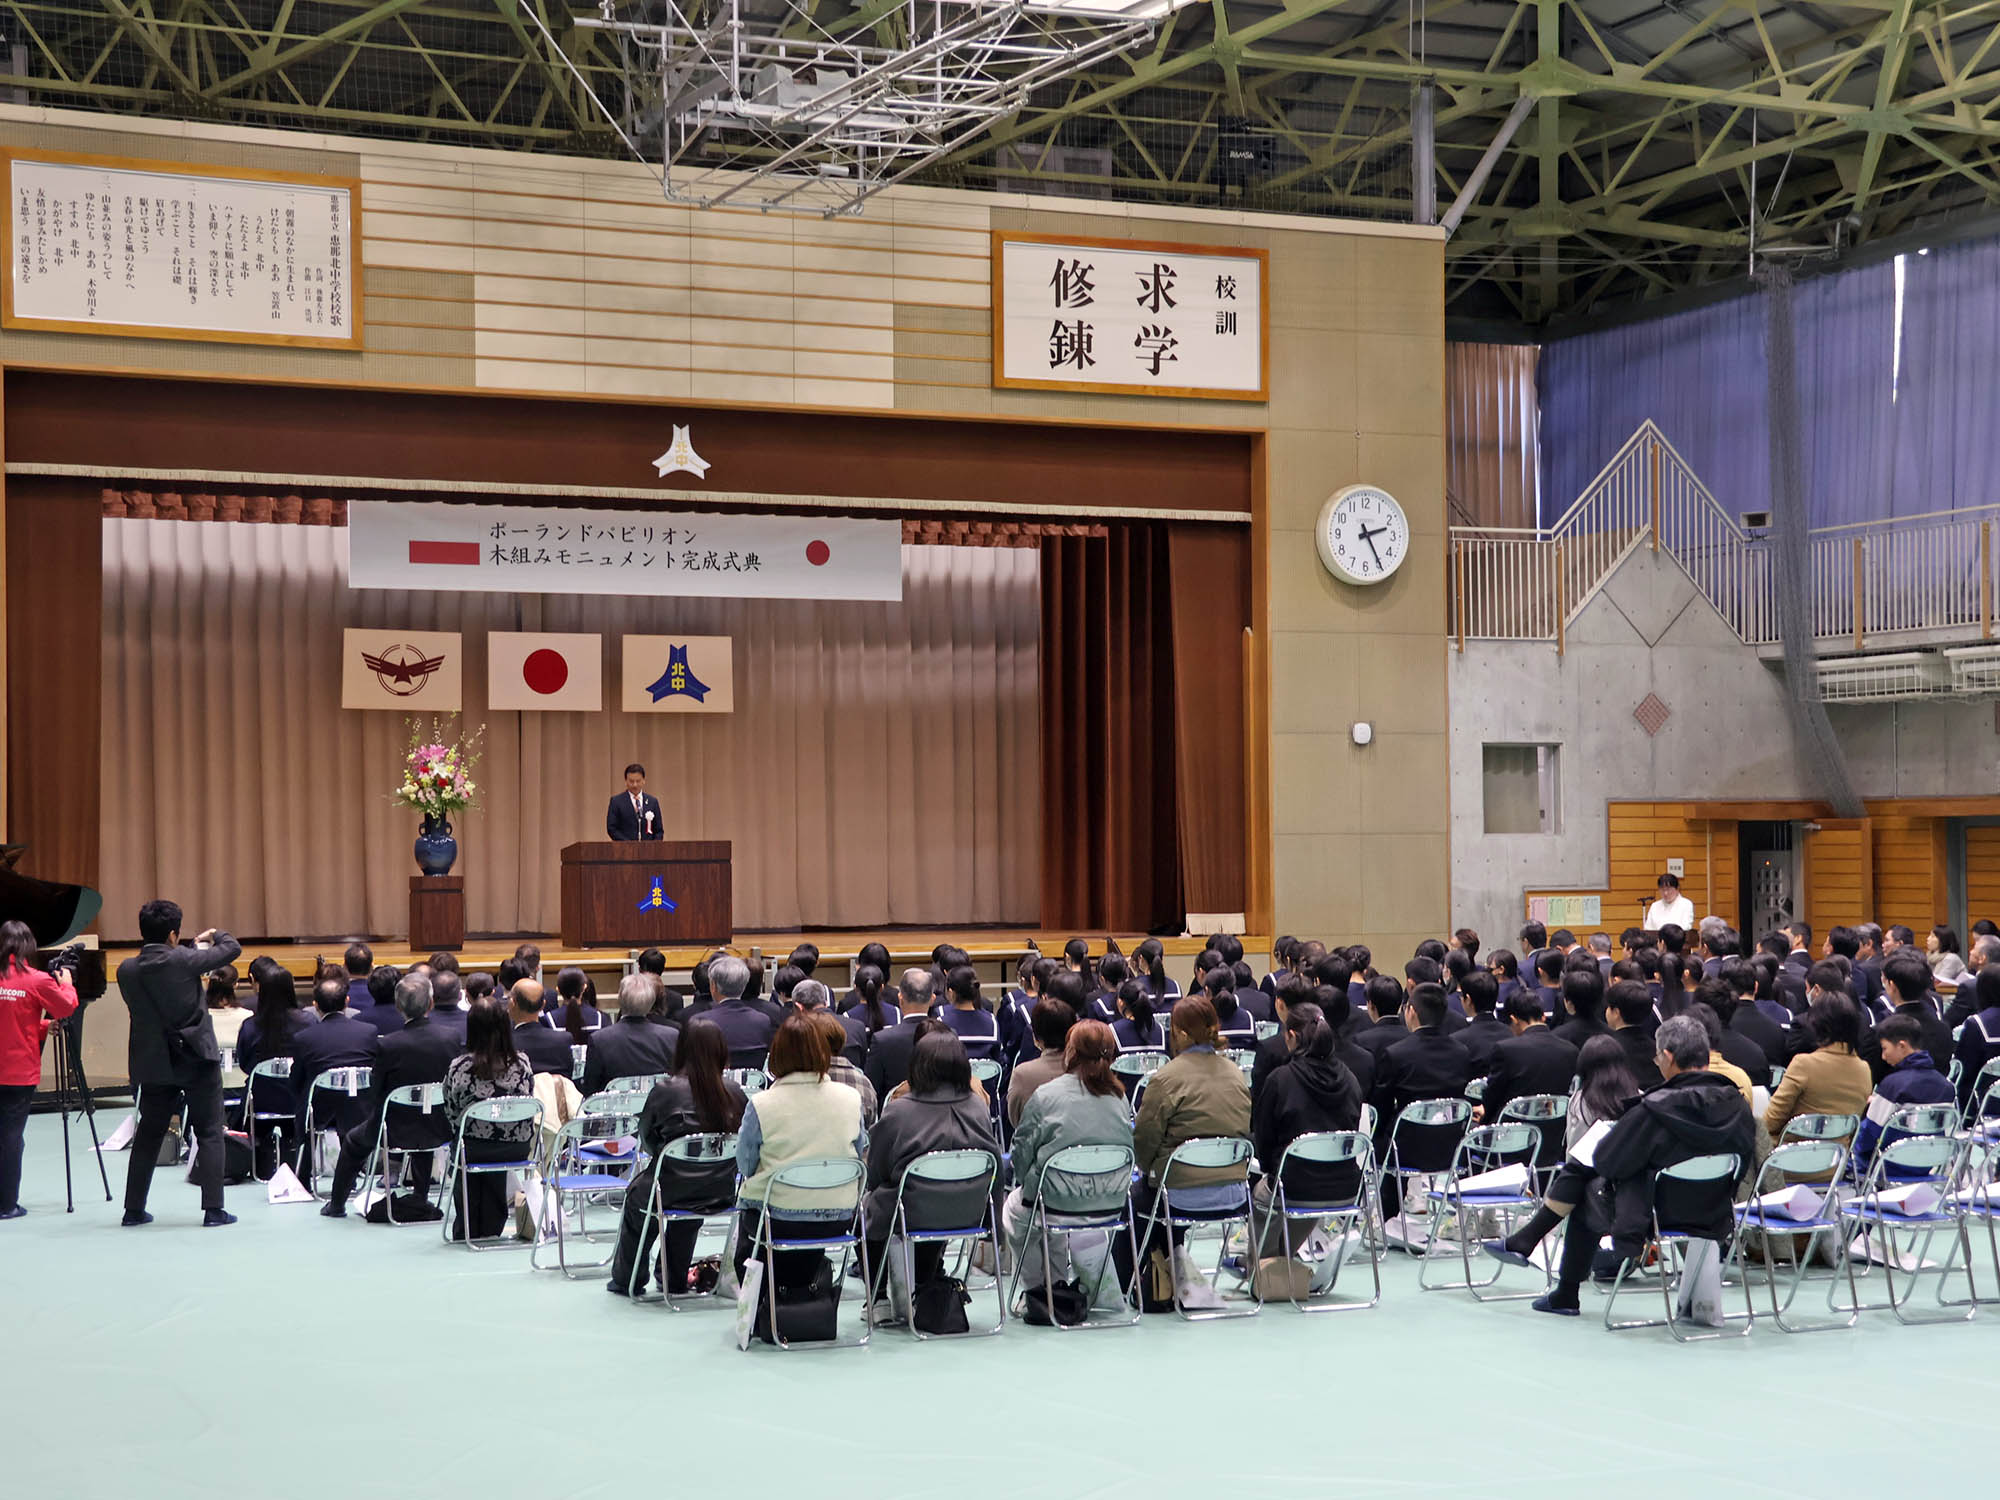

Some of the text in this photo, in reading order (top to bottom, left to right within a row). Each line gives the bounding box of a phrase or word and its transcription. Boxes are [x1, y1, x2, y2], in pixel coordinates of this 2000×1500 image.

[53, 199, 64, 266] かがやけ 北中
[69, 200, 80, 259] すすめ 北中
[86, 250, 96, 269] ああ
[255, 253, 265, 272] 北中
[240, 261, 250, 280] 北中
[271, 264, 280, 282] ああ
[329, 234, 342, 327] 恵那北中学校校歌
[1215, 274, 1237, 336] 校訓
[1133, 263, 1179, 376] 求学
[1348, 501, 1356, 512] 11
[1361, 497, 1370, 509] 12
[1377, 502, 1381, 514] 1
[1337, 512, 1347, 524] 10
[1386, 514, 1393, 526] 2
[489, 521, 698, 545] ポーランドパビリオン
[1334, 528, 1342, 540] 9
[1390, 530, 1397, 542] 3
[488, 544, 763, 573] 木組みモニュメント完成式典
[1338, 544, 1346, 556] 8
[1385, 546, 1393, 557] 4
[1349, 556, 1356, 568] 7
[1362, 561, 1369, 572] 6
[671, 662, 686, 692] 北中
[652, 887, 662, 907] 北中
